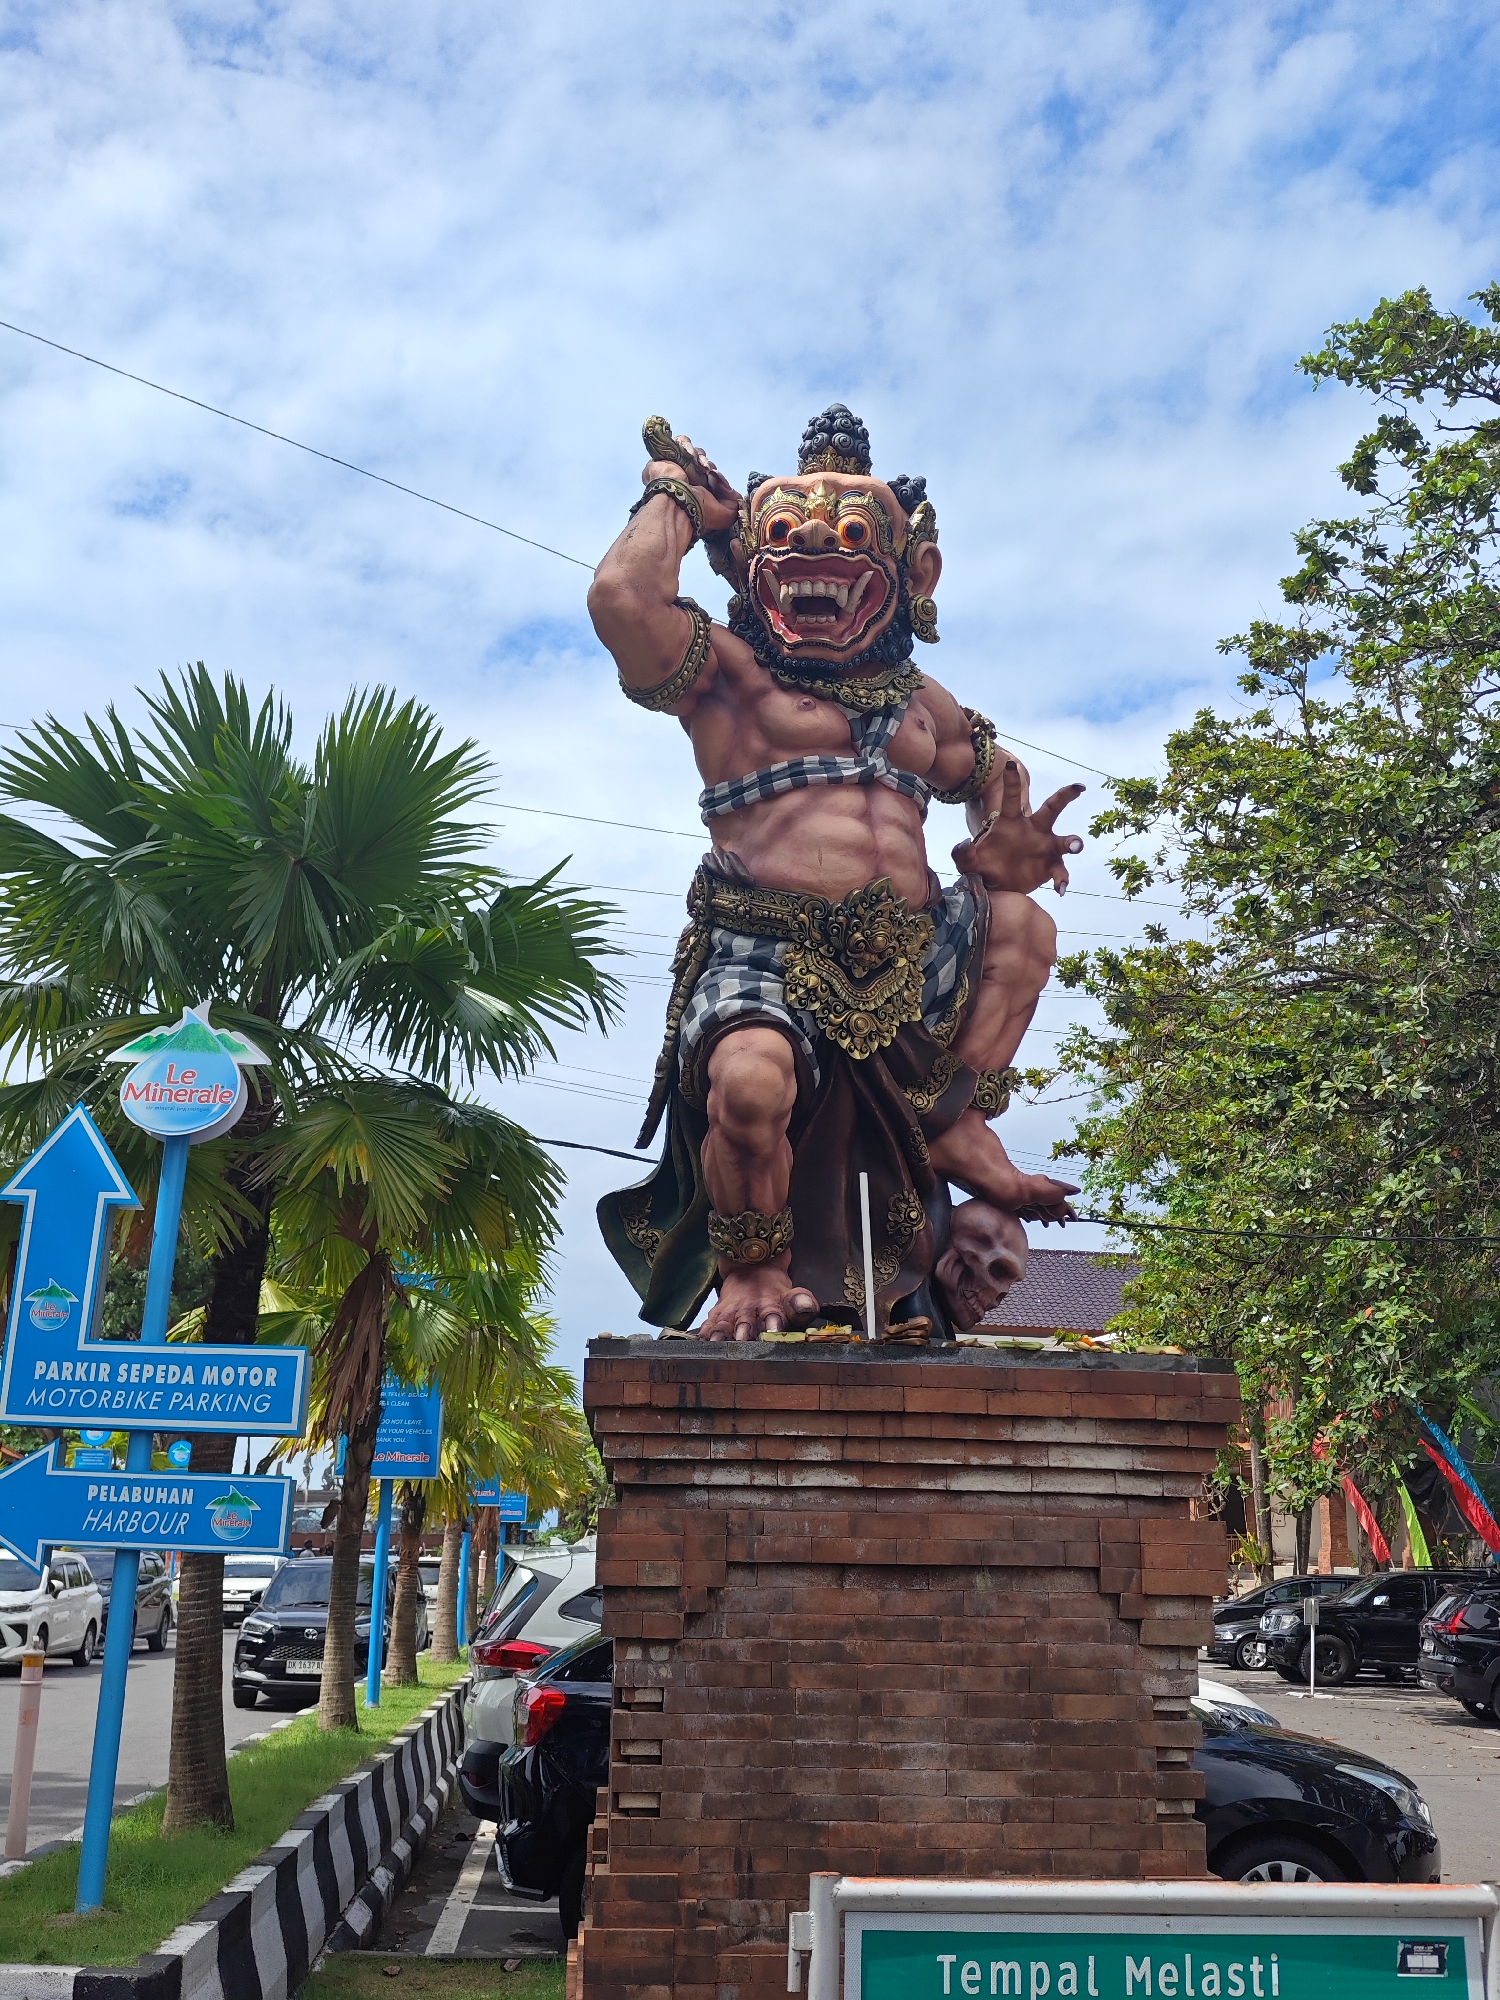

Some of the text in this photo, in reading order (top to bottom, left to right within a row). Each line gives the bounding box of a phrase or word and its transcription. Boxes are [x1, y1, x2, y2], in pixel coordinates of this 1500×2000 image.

[166, 1063, 197, 1086] Le
[122, 1082, 235, 1105] Minerale
[31, 1309, 69, 1319] Minerale
[44, 1301, 57, 1311] Le
[34, 1360, 278, 1387] PARKIR SEPEDA MOTOR
[25, 1387, 272, 1413] MOTORBIKE PARKING
[373, 1450, 430, 1463] Le Minerale
[87, 1484, 194, 1505] PELABUHAN
[82, 1509, 190, 1535] HARBOUR
[212, 1518, 251, 1528] Minerale
[226, 1510, 238, 1520] Le
[1125, 1953, 1280, 1997] Melasti
